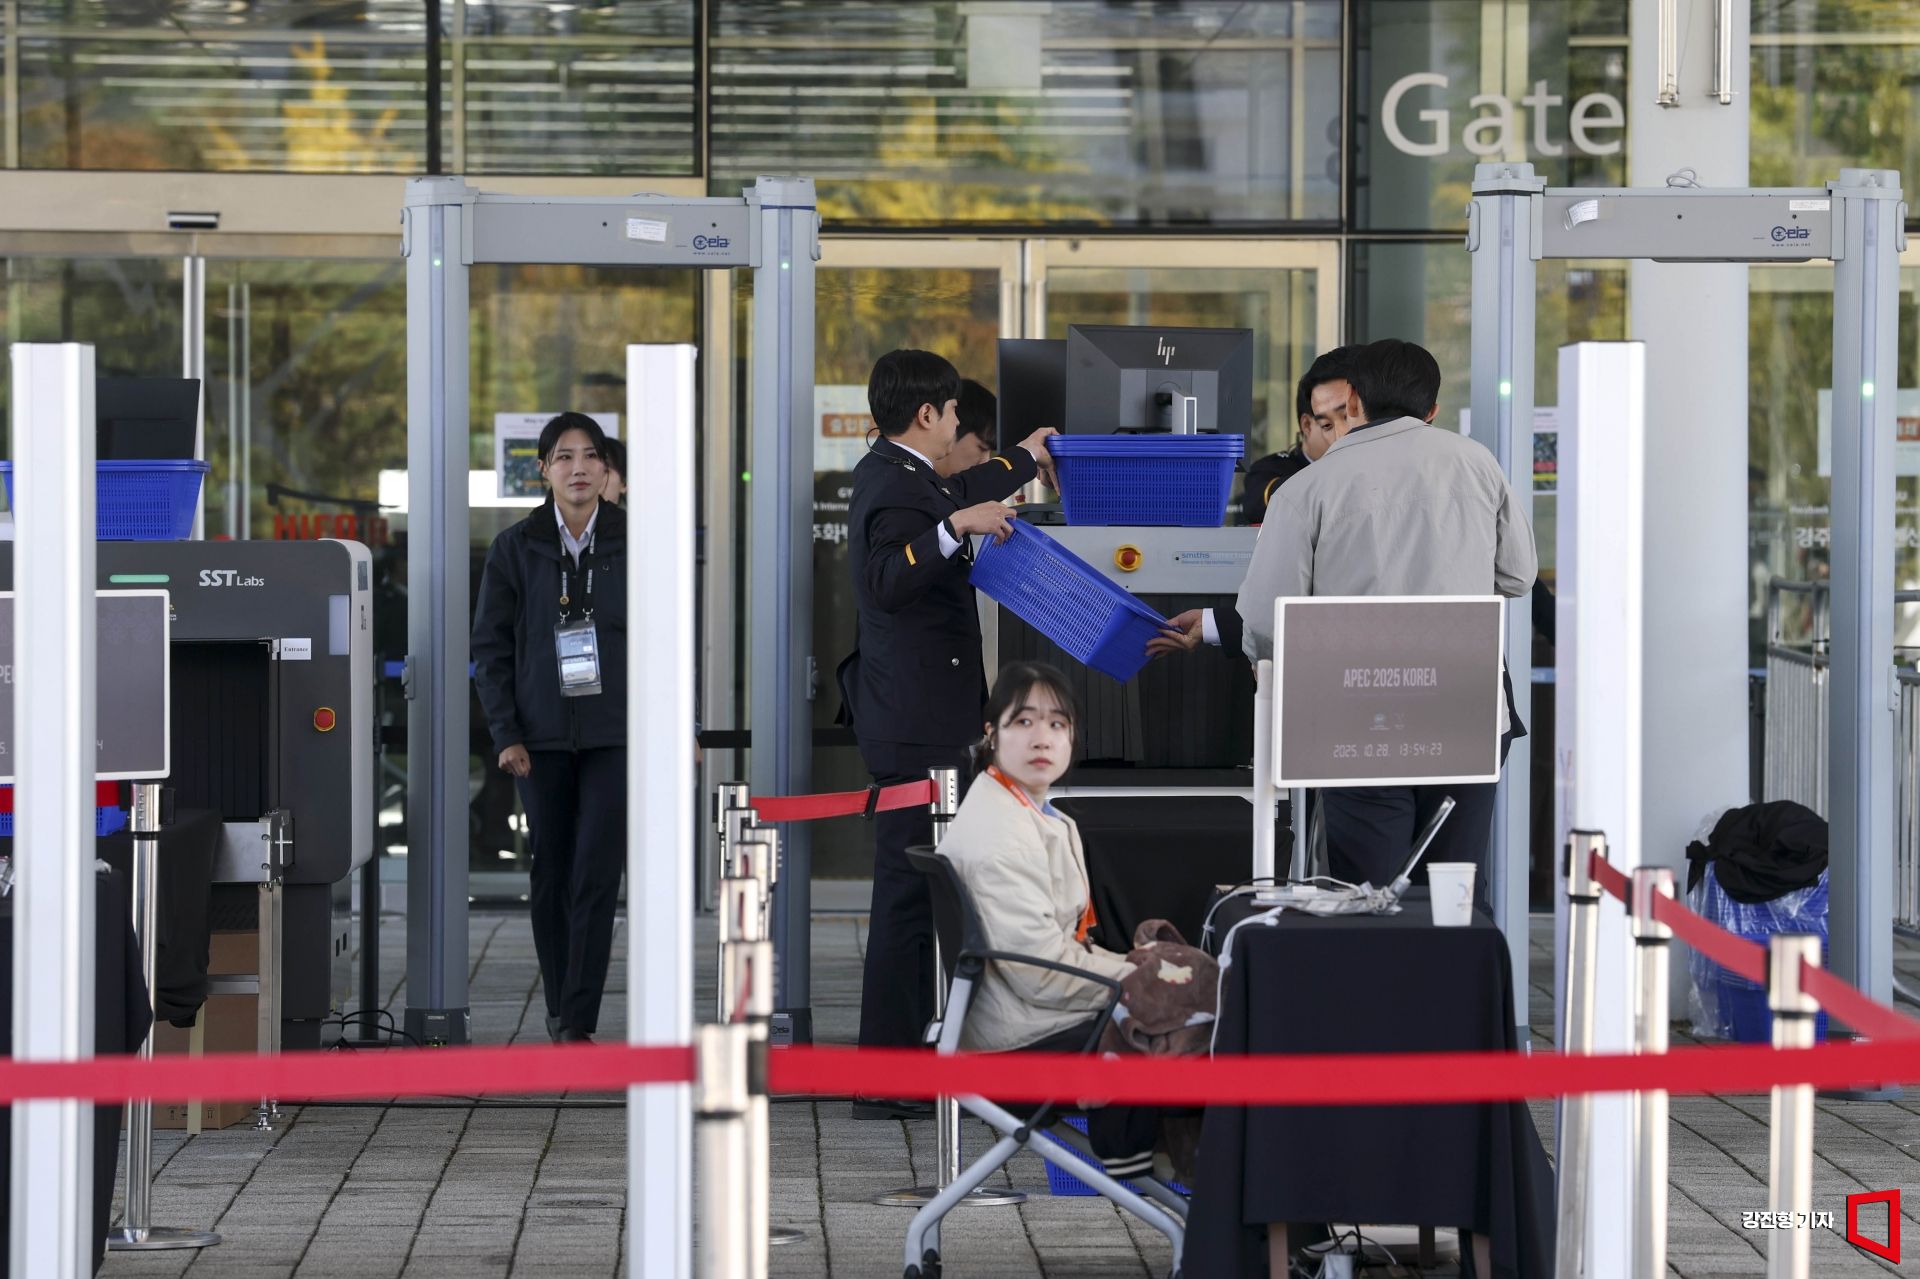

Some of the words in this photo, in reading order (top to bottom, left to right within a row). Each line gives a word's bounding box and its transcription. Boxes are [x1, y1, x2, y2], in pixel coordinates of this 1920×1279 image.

[1381, 72, 1625, 157] Gate
[199, 569, 237, 587] SST
[237, 576, 265, 587] Labs
[1343, 668, 1371, 688] APEC
[1373, 668, 1400, 688] 2025
[1403, 667, 1437, 687] KOREA
